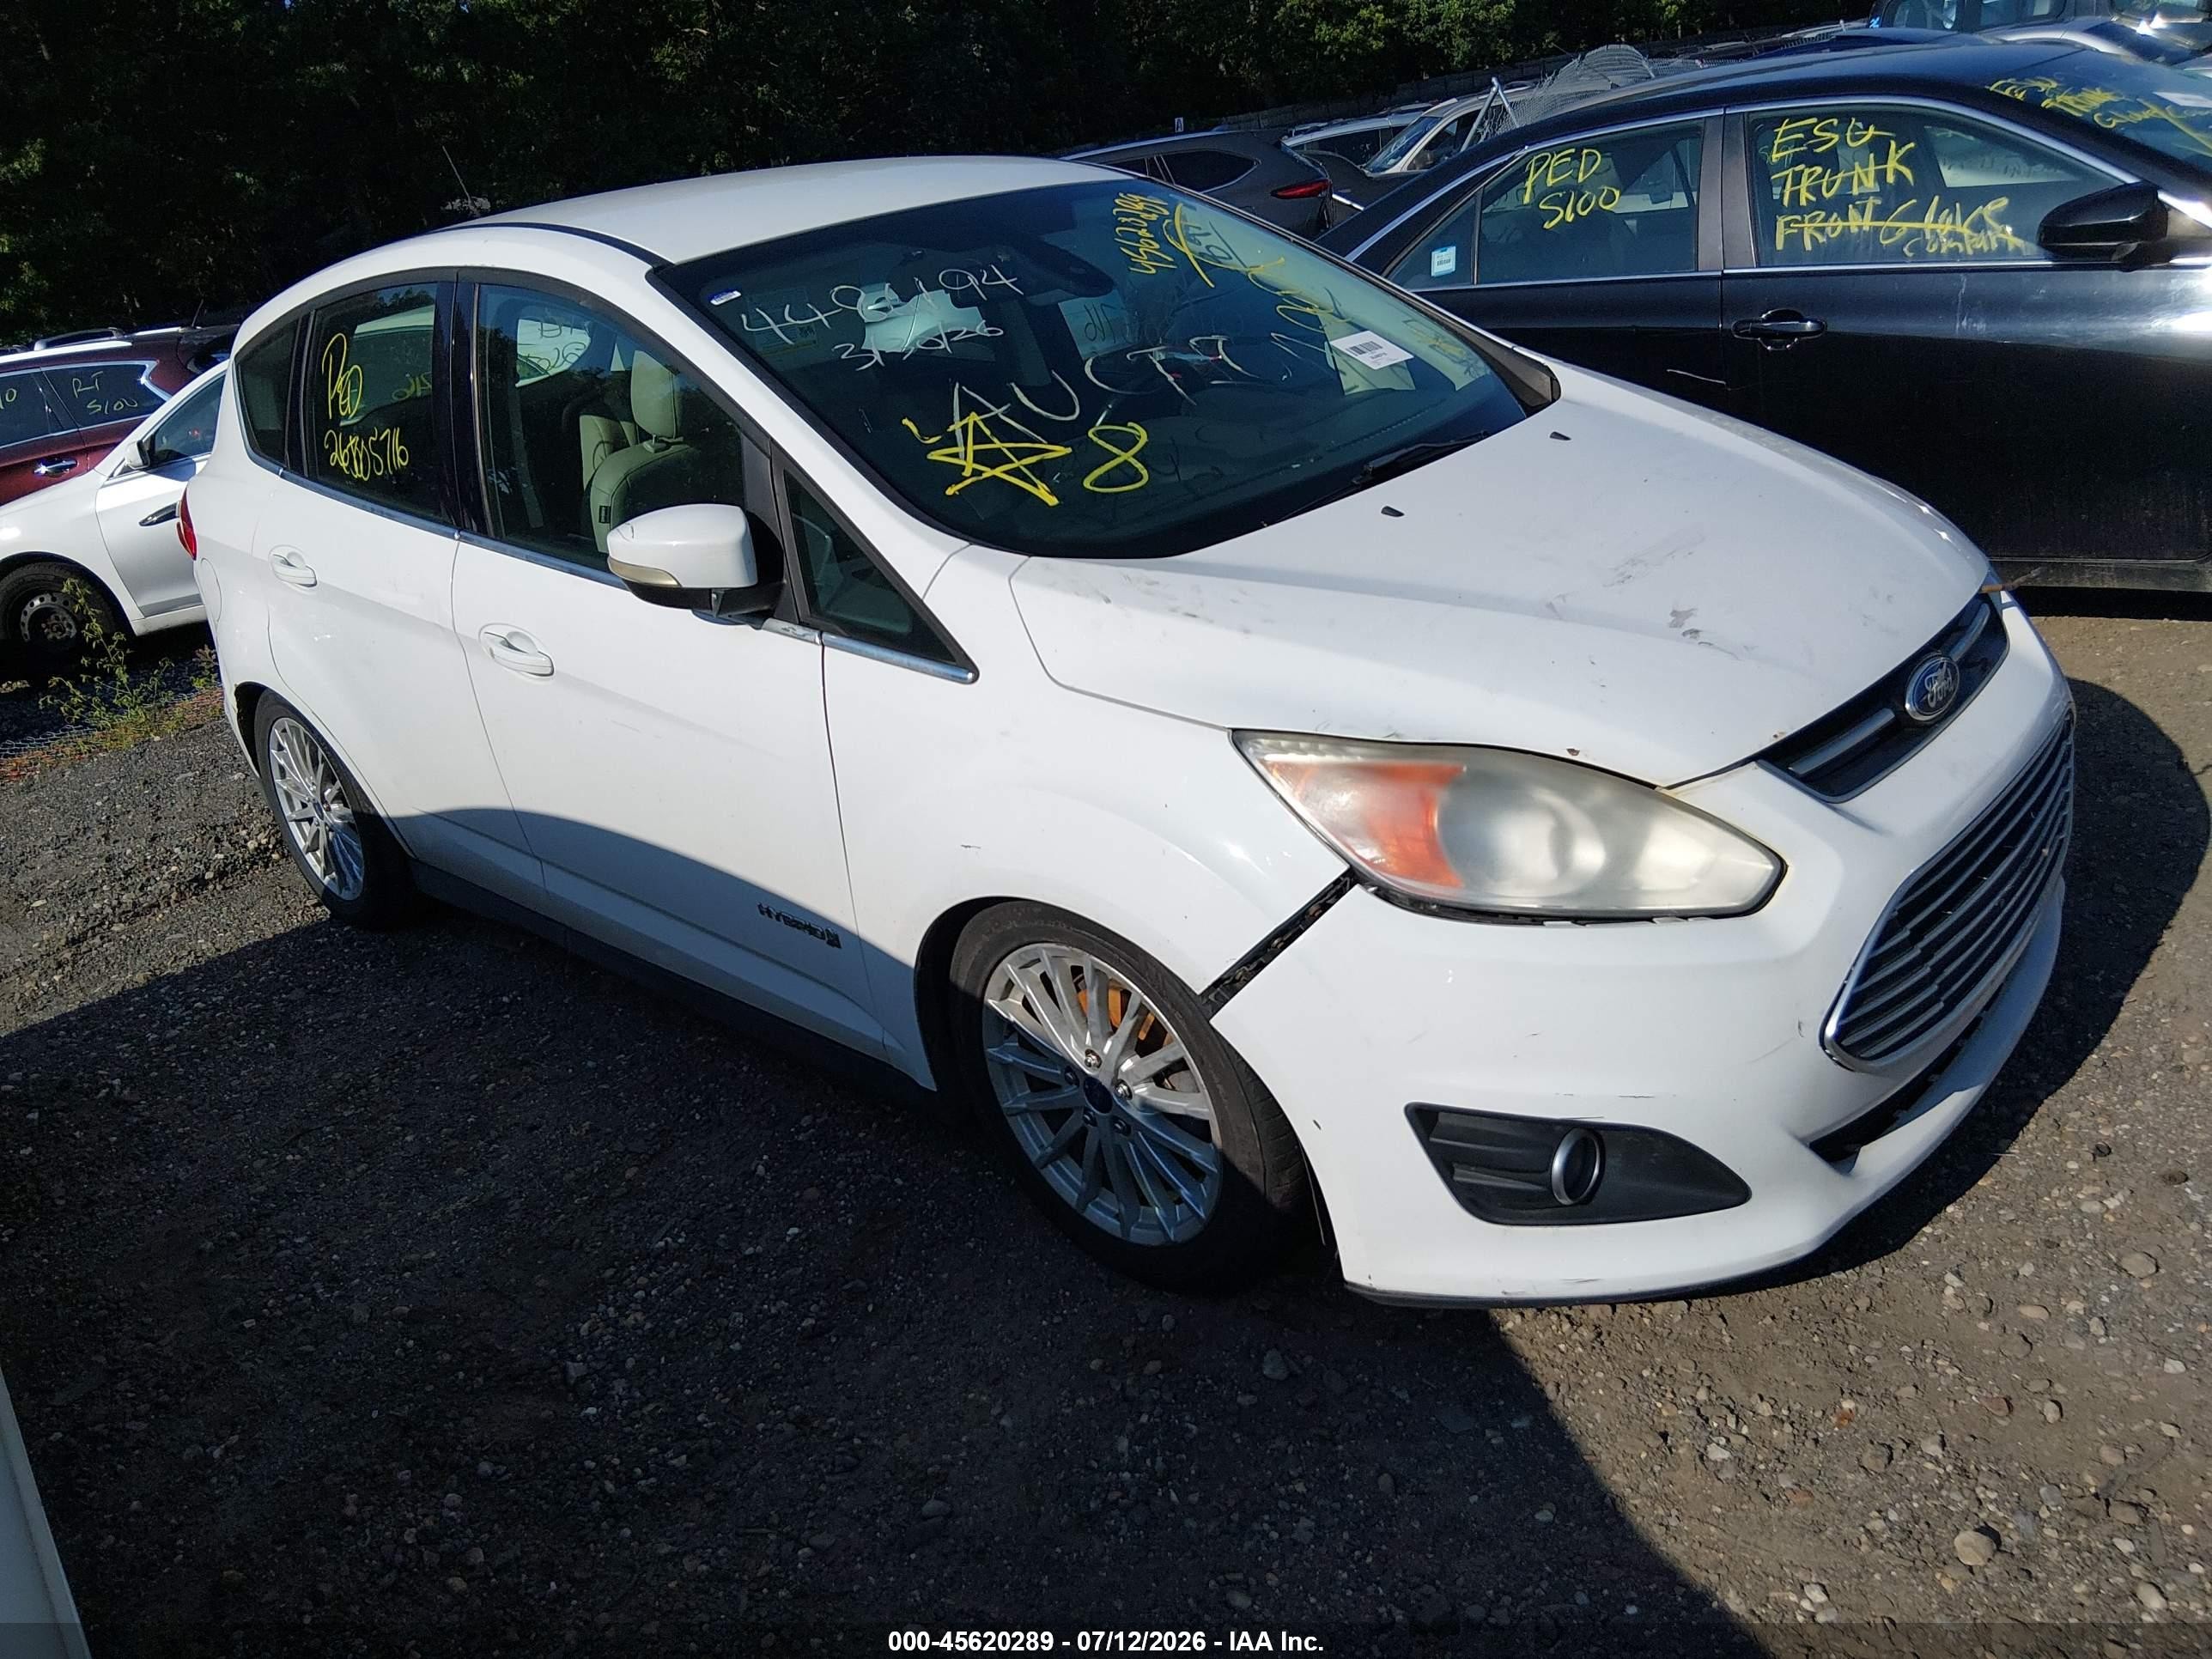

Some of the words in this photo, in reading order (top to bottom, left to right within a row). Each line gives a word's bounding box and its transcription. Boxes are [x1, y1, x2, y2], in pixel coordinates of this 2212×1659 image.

[1522, 148, 1601, 205] PED
[1771, 140, 1916, 207] TRUNK
[1081, 422, 1150, 493] 8
